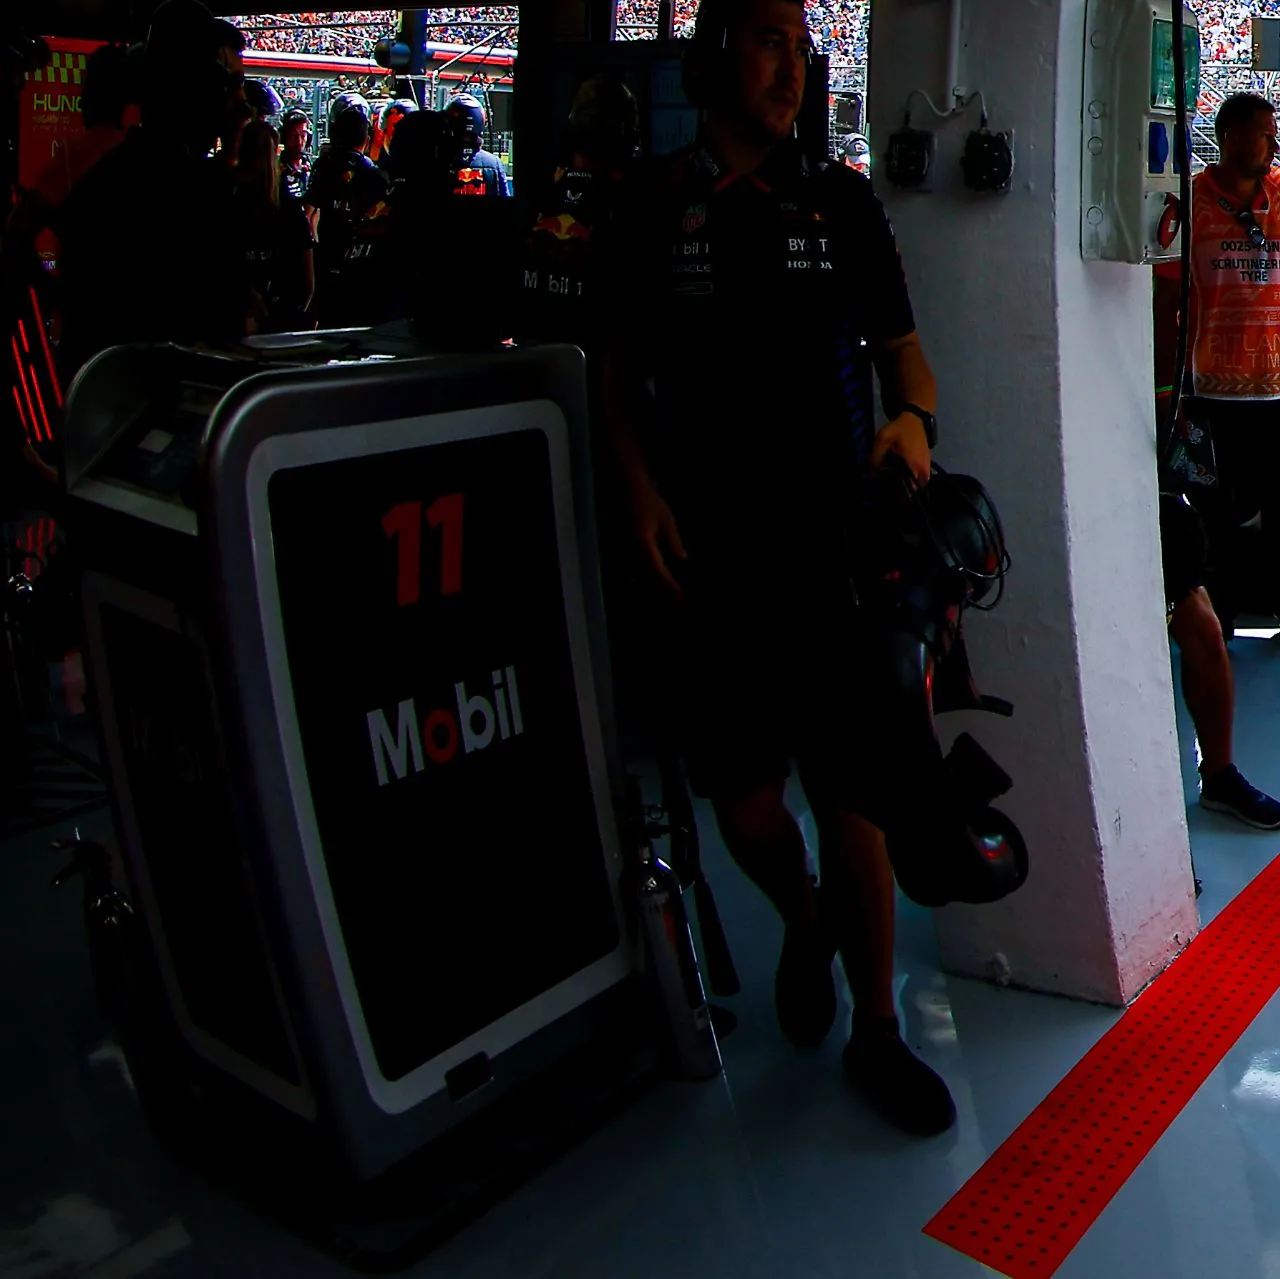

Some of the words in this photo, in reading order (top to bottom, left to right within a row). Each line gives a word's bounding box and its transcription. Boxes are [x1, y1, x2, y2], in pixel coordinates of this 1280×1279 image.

[524, 269, 569, 295] Mbil
[1240, 271, 1268, 281] TYRE
[381, 493, 464, 606] 11
[366, 665, 524, 786] Mobil
